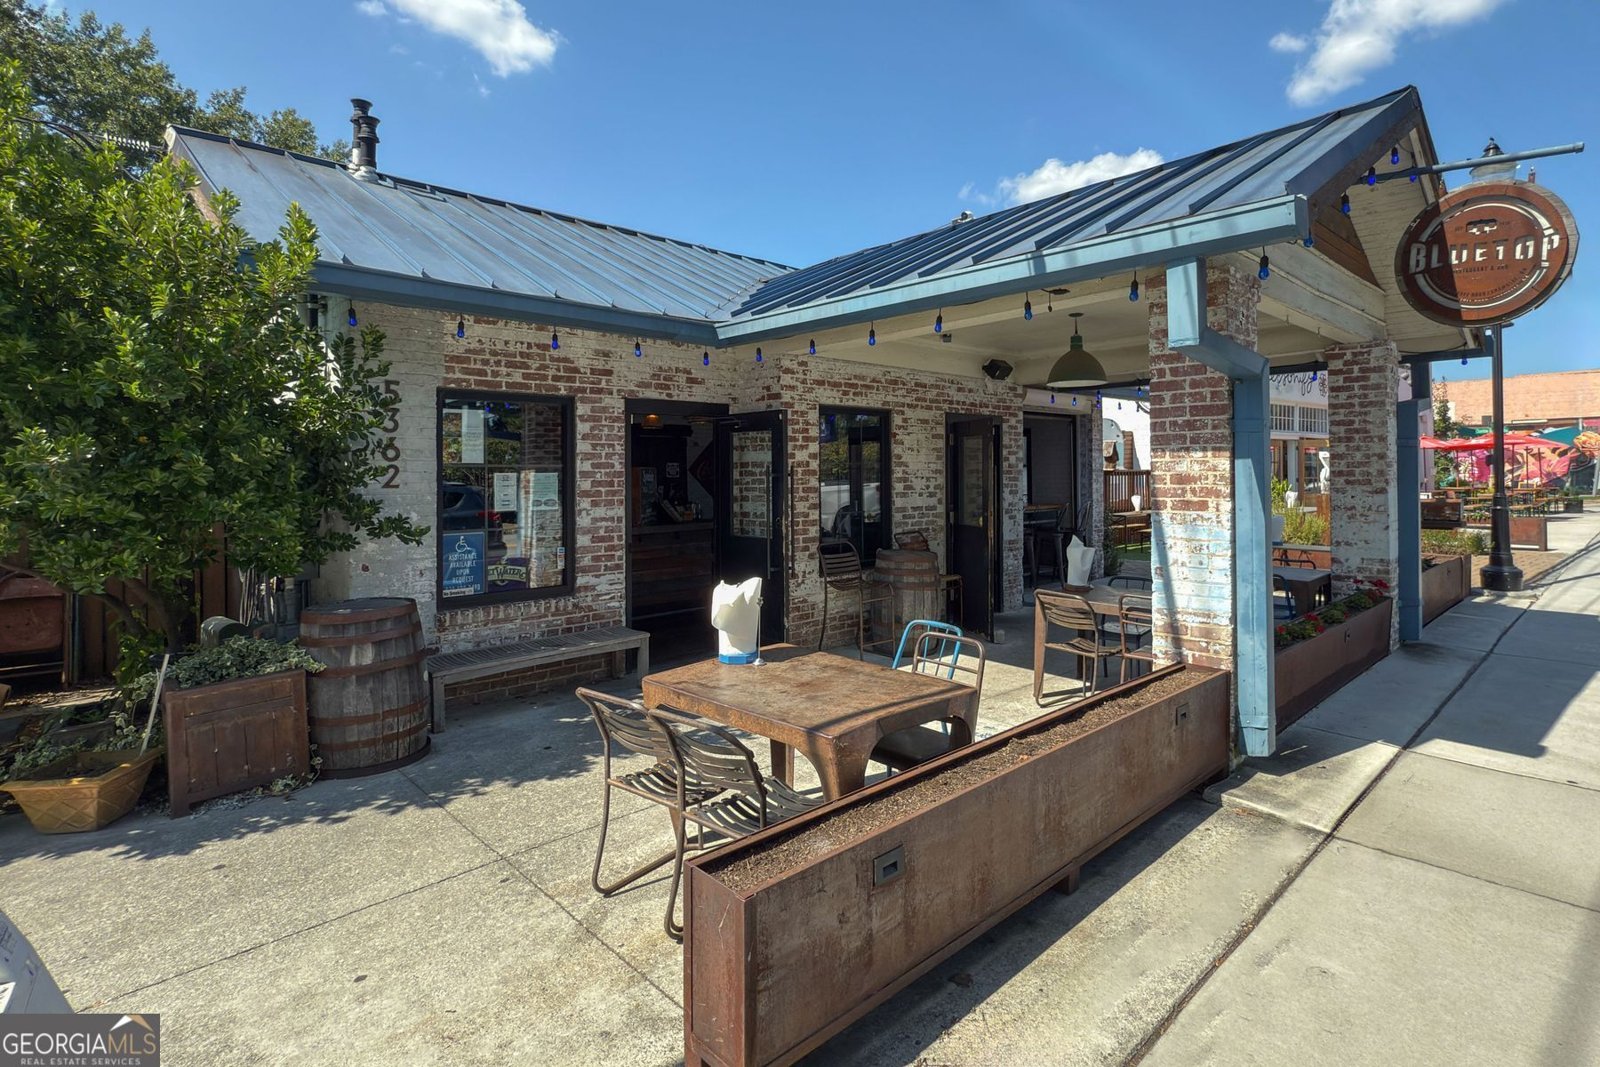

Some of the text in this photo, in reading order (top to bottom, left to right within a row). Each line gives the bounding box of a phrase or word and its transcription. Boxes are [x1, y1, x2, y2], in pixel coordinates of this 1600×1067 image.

[1409, 234, 1560, 274] BLUETOP
[382, 381, 400, 489] 5362
[448, 553, 478, 561] ASSISTANCE
[449, 561, 477, 569] AVAILABLE
[452, 575, 474, 584] REQUEST
